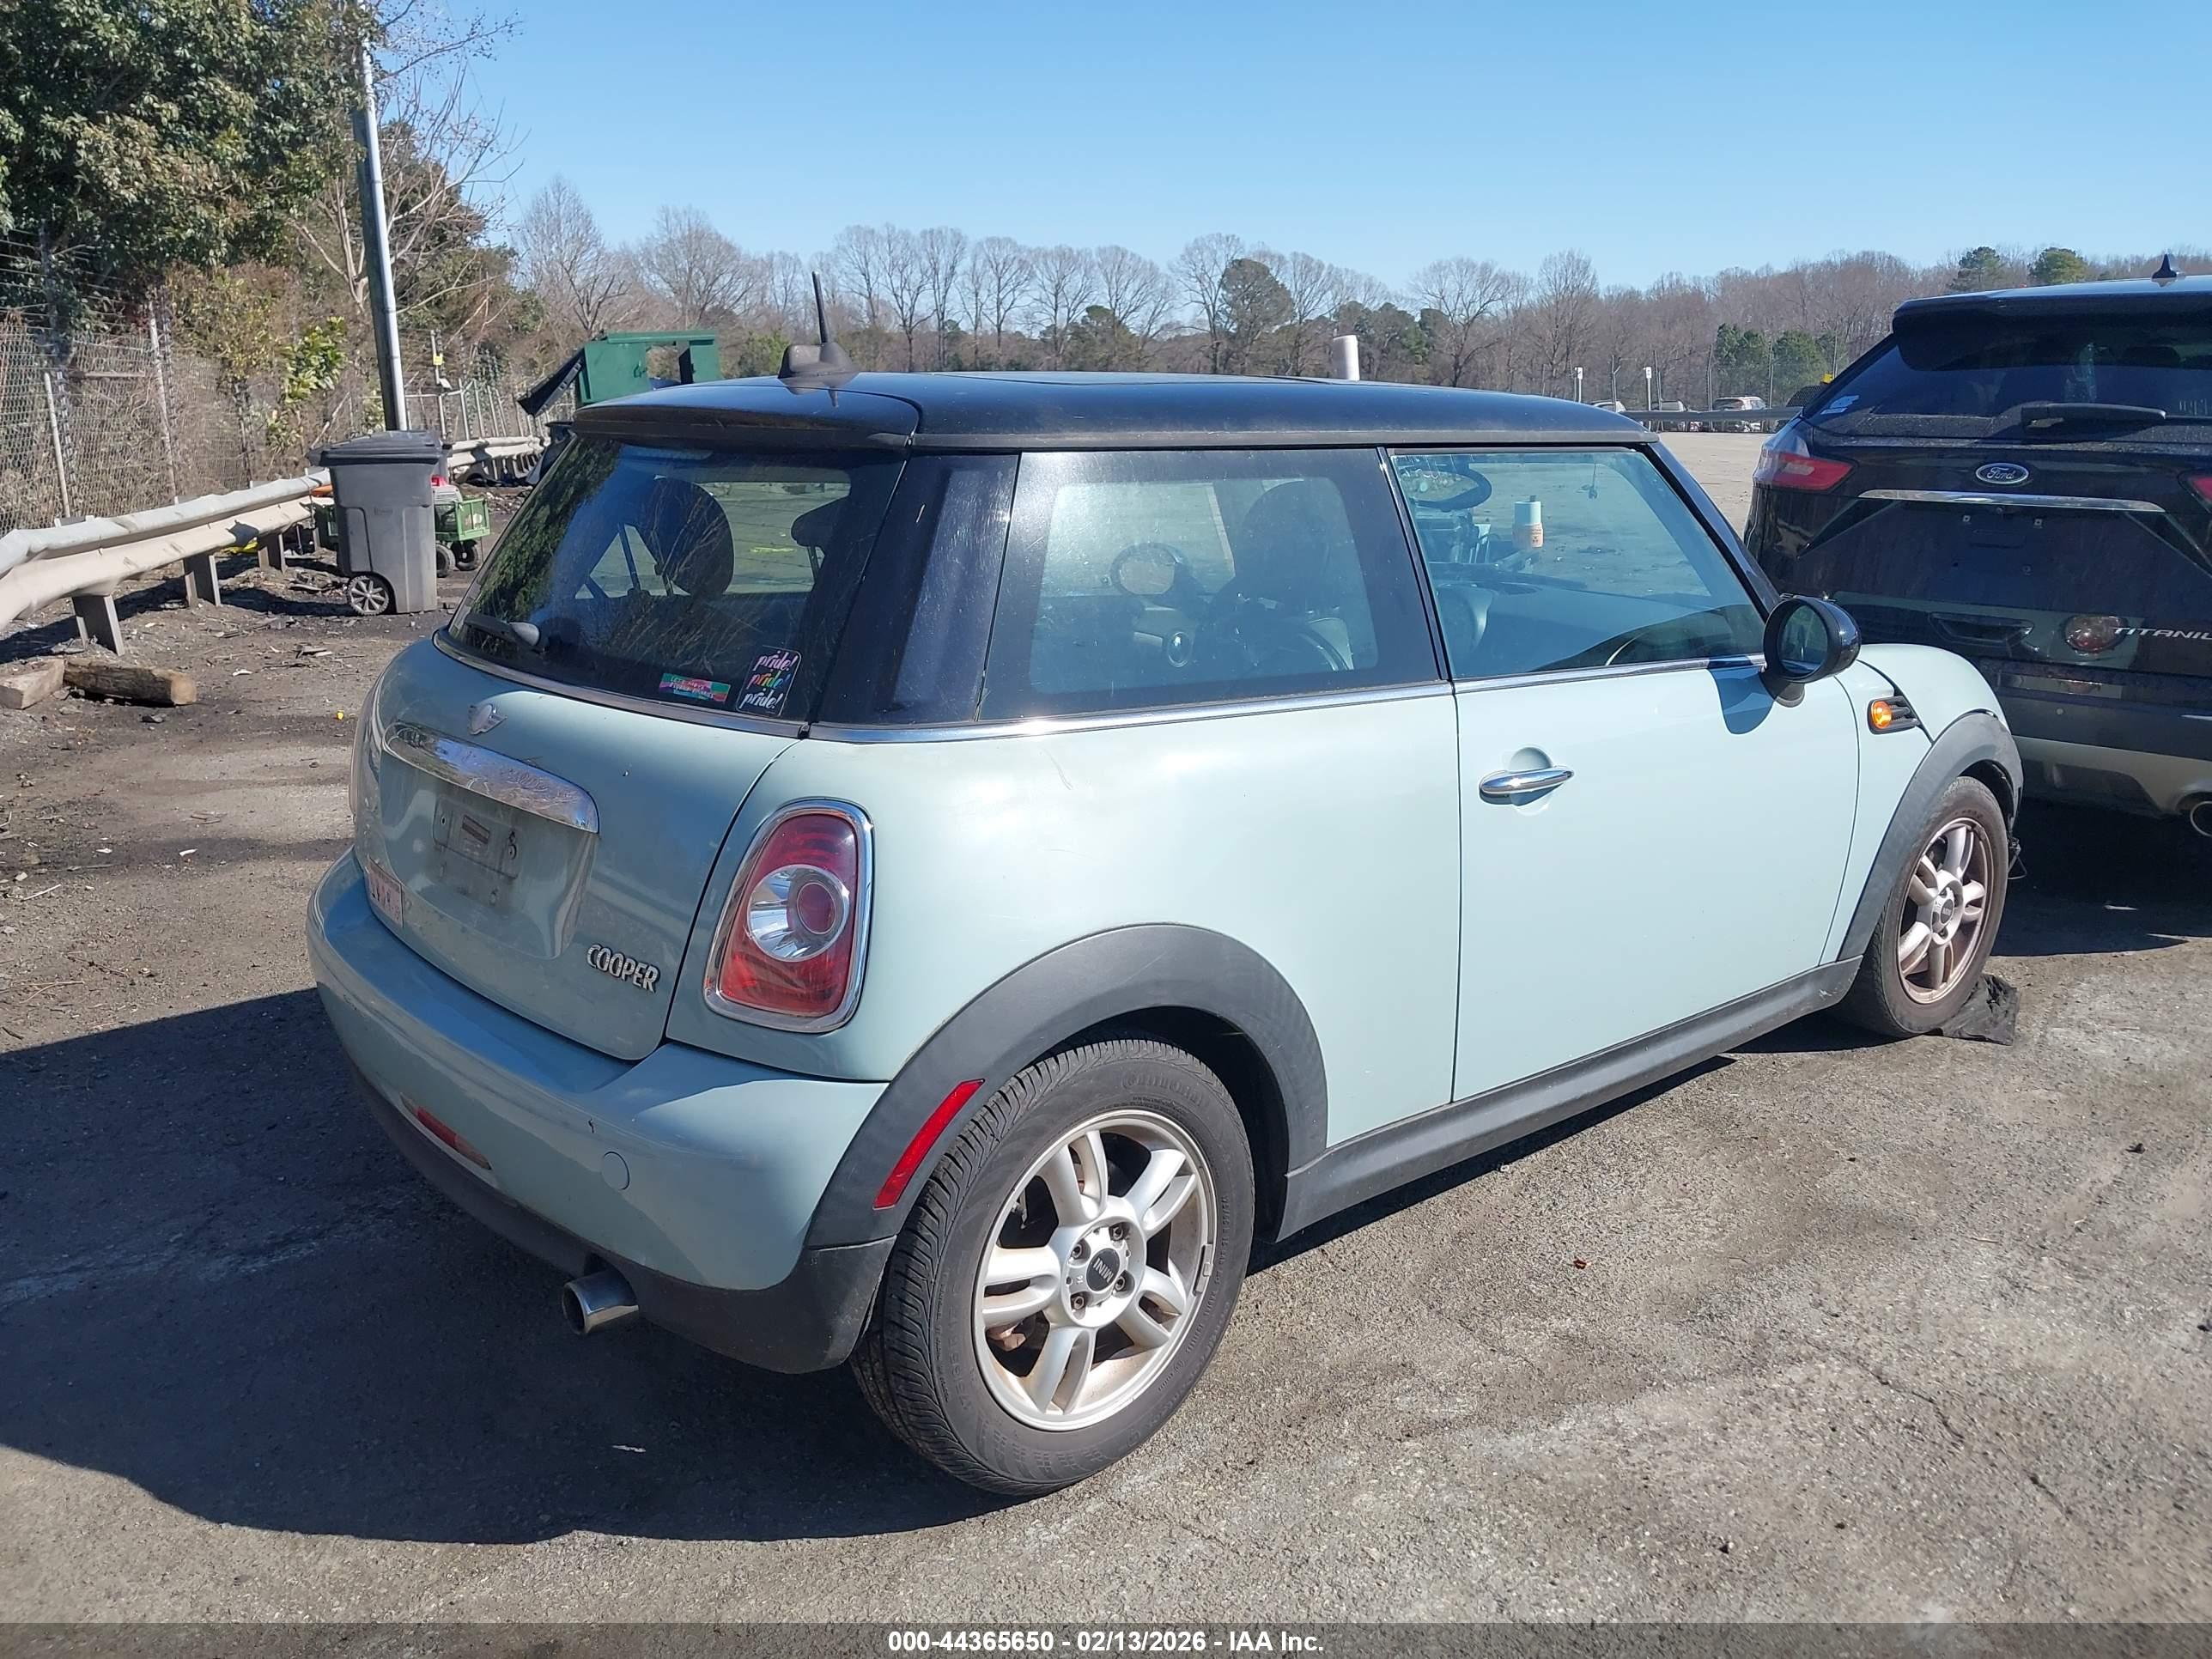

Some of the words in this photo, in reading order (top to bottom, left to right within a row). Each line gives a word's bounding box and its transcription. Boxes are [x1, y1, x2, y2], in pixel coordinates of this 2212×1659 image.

[1986, 466, 2016, 480] Ford
[752, 650, 799, 672] pride!
[738, 688, 784, 709] pride!
[586, 944, 659, 992] COOPER
[1092, 1256, 1115, 1284] MINI
